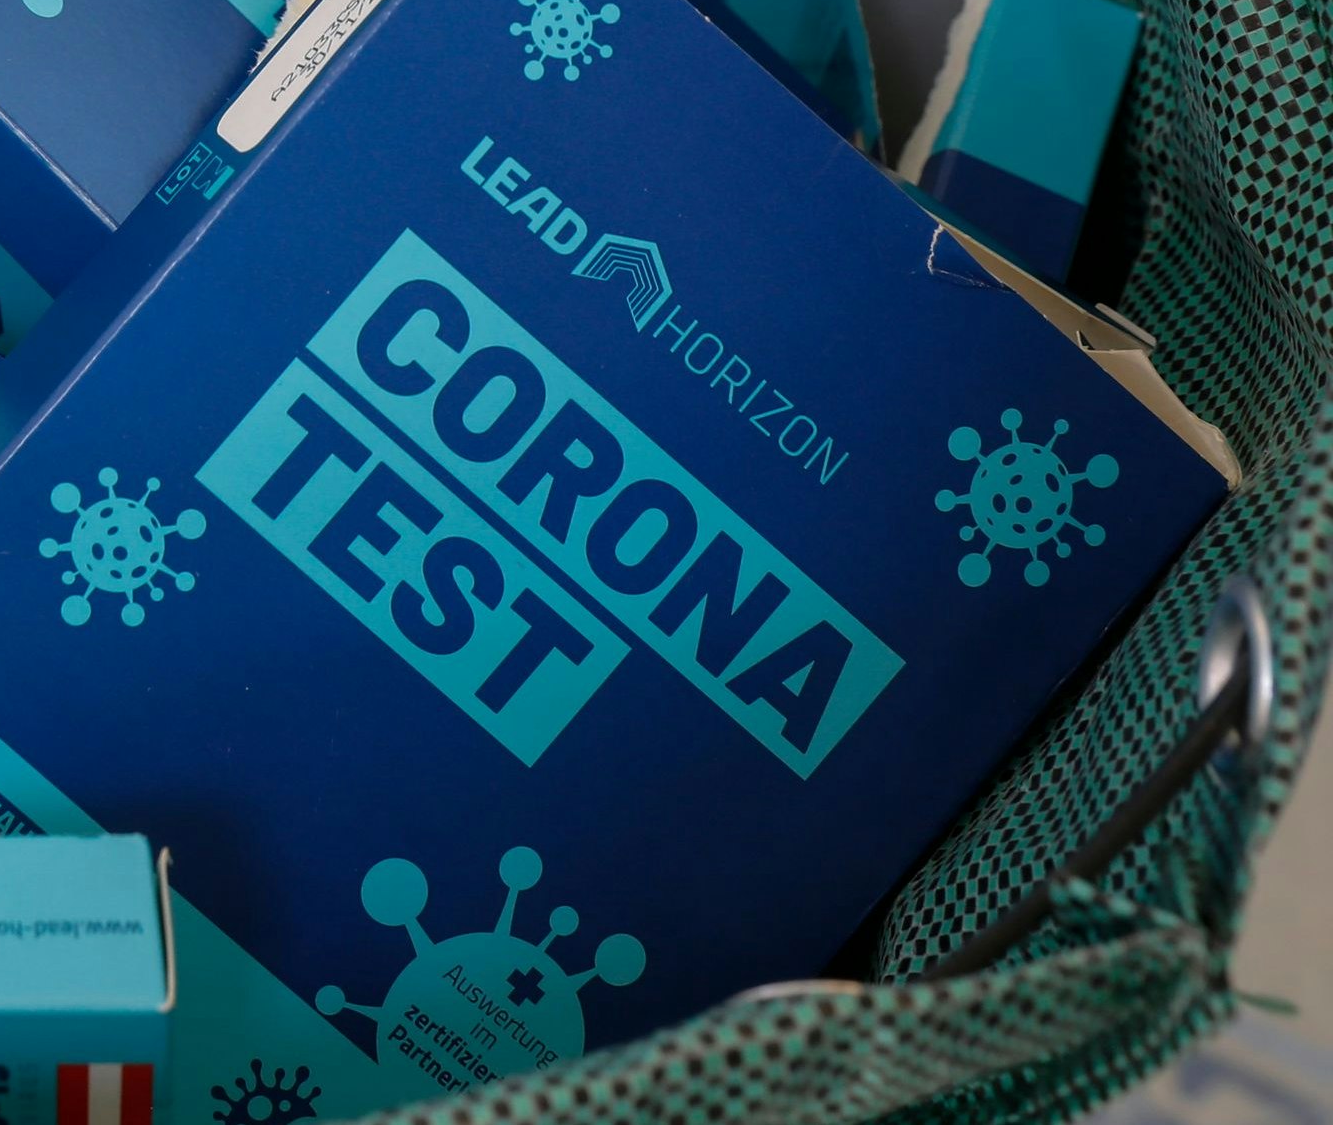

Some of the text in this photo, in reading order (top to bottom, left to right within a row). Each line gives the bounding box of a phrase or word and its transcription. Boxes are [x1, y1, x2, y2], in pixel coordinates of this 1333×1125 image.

[165, 149, 205, 195] LOT
[460, 135, 849, 485] LEAD HORIZON
[251, 392, 595, 714] TEST
[356, 279, 854, 756] CORONA
[404, 1004, 505, 1085] zertifizier
[442, 964, 559, 1070] Auswertung
[470, 1018, 497, 1050] im
